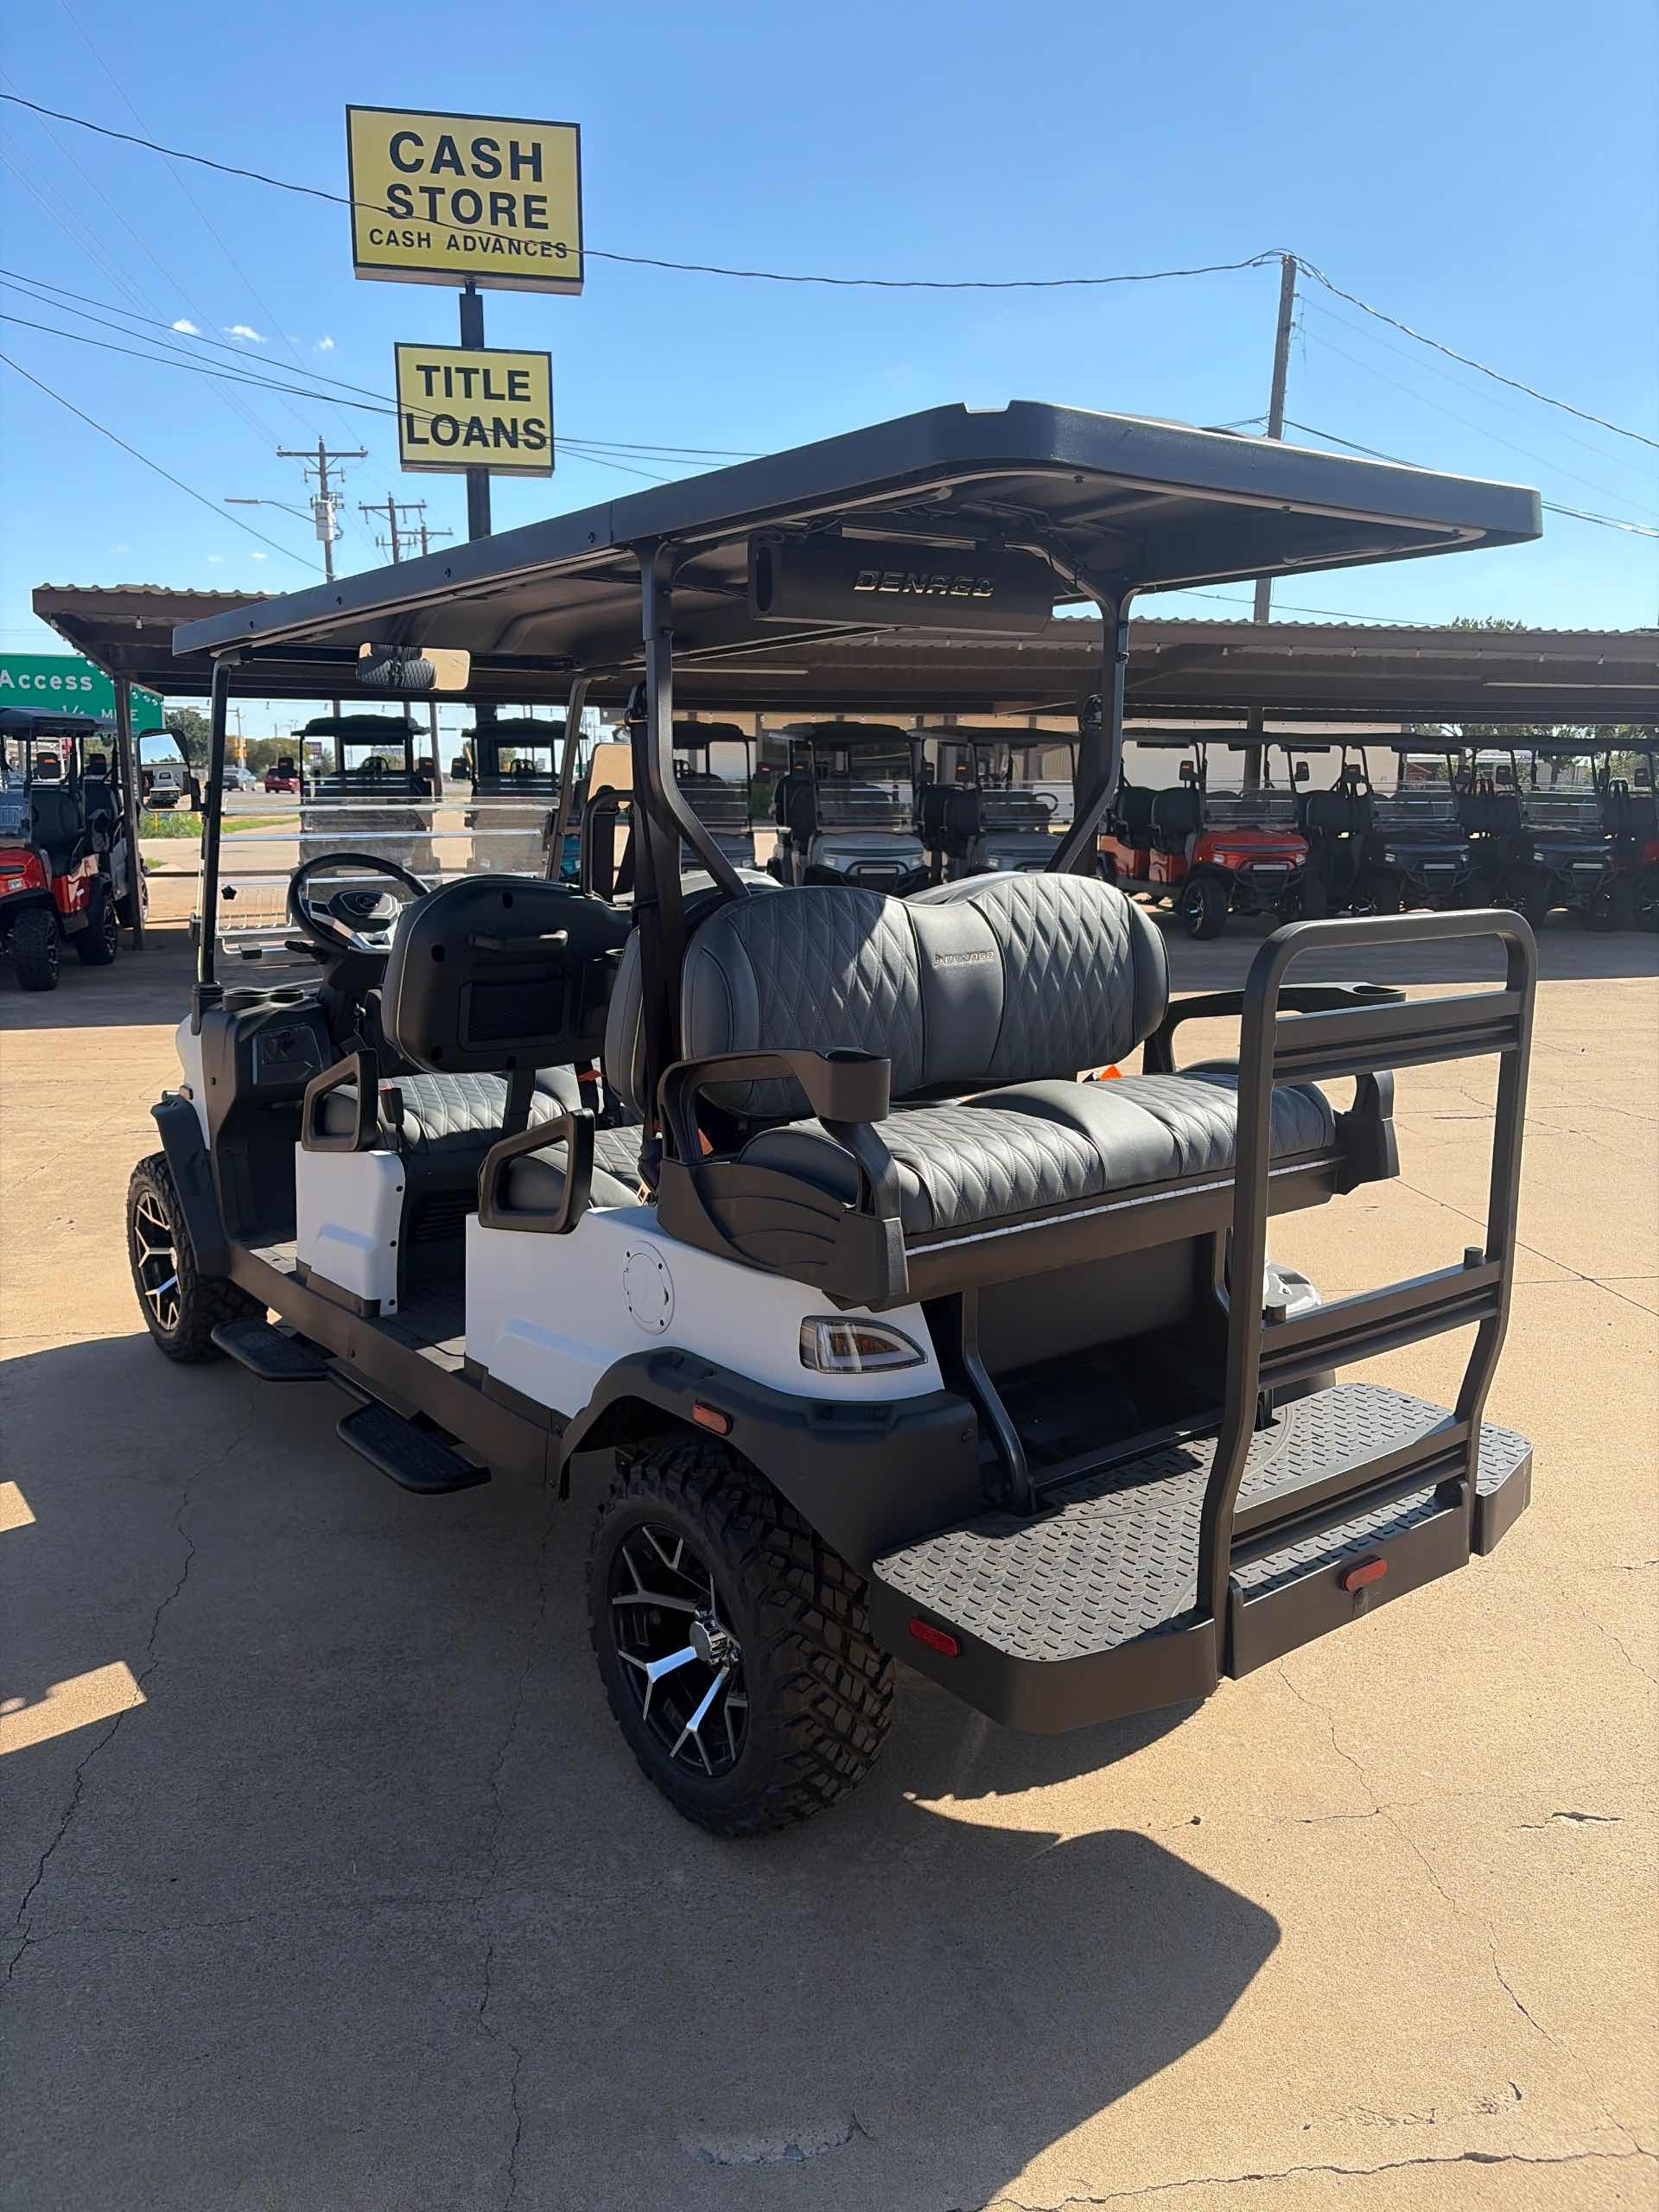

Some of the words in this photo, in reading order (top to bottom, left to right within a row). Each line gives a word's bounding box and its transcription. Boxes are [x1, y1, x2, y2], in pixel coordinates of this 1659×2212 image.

[390, 131, 543, 182] CASH
[386, 183, 550, 230] STORE
[369, 228, 431, 249] CASH
[446, 234, 568, 259] ADVANCES
[416, 364, 531, 403] TITLE
[406, 413, 547, 450] LOANS
[854, 570, 995, 597] DENAGO
[0, 670, 93, 691] Access
[101, 709, 139, 721] MIE
